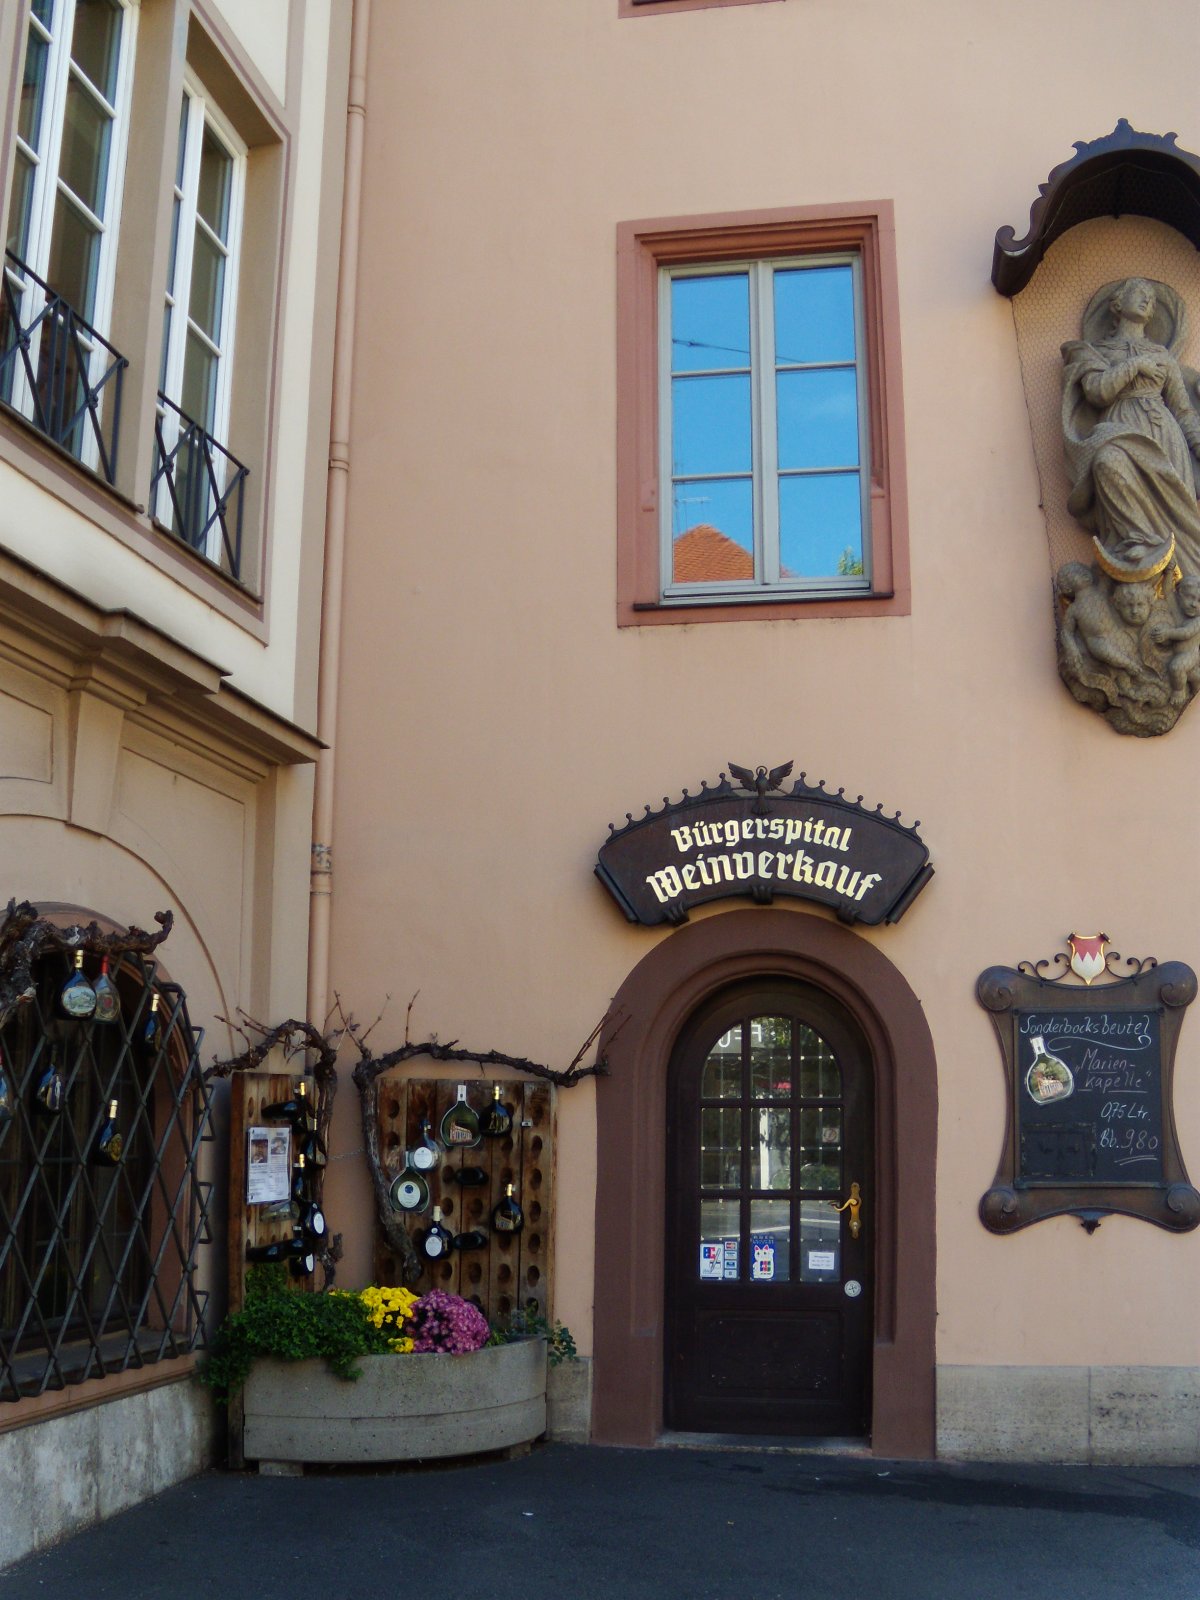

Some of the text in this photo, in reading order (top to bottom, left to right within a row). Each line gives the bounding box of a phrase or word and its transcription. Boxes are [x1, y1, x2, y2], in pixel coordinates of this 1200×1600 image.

[671, 816, 852, 852] Bürgerspital
[646, 849, 883, 903] Weinverkauf
[1100, 1102, 1151, 1123] 0,75 Ltr.
[1120, 1128, 1158, 1154] 9,80
